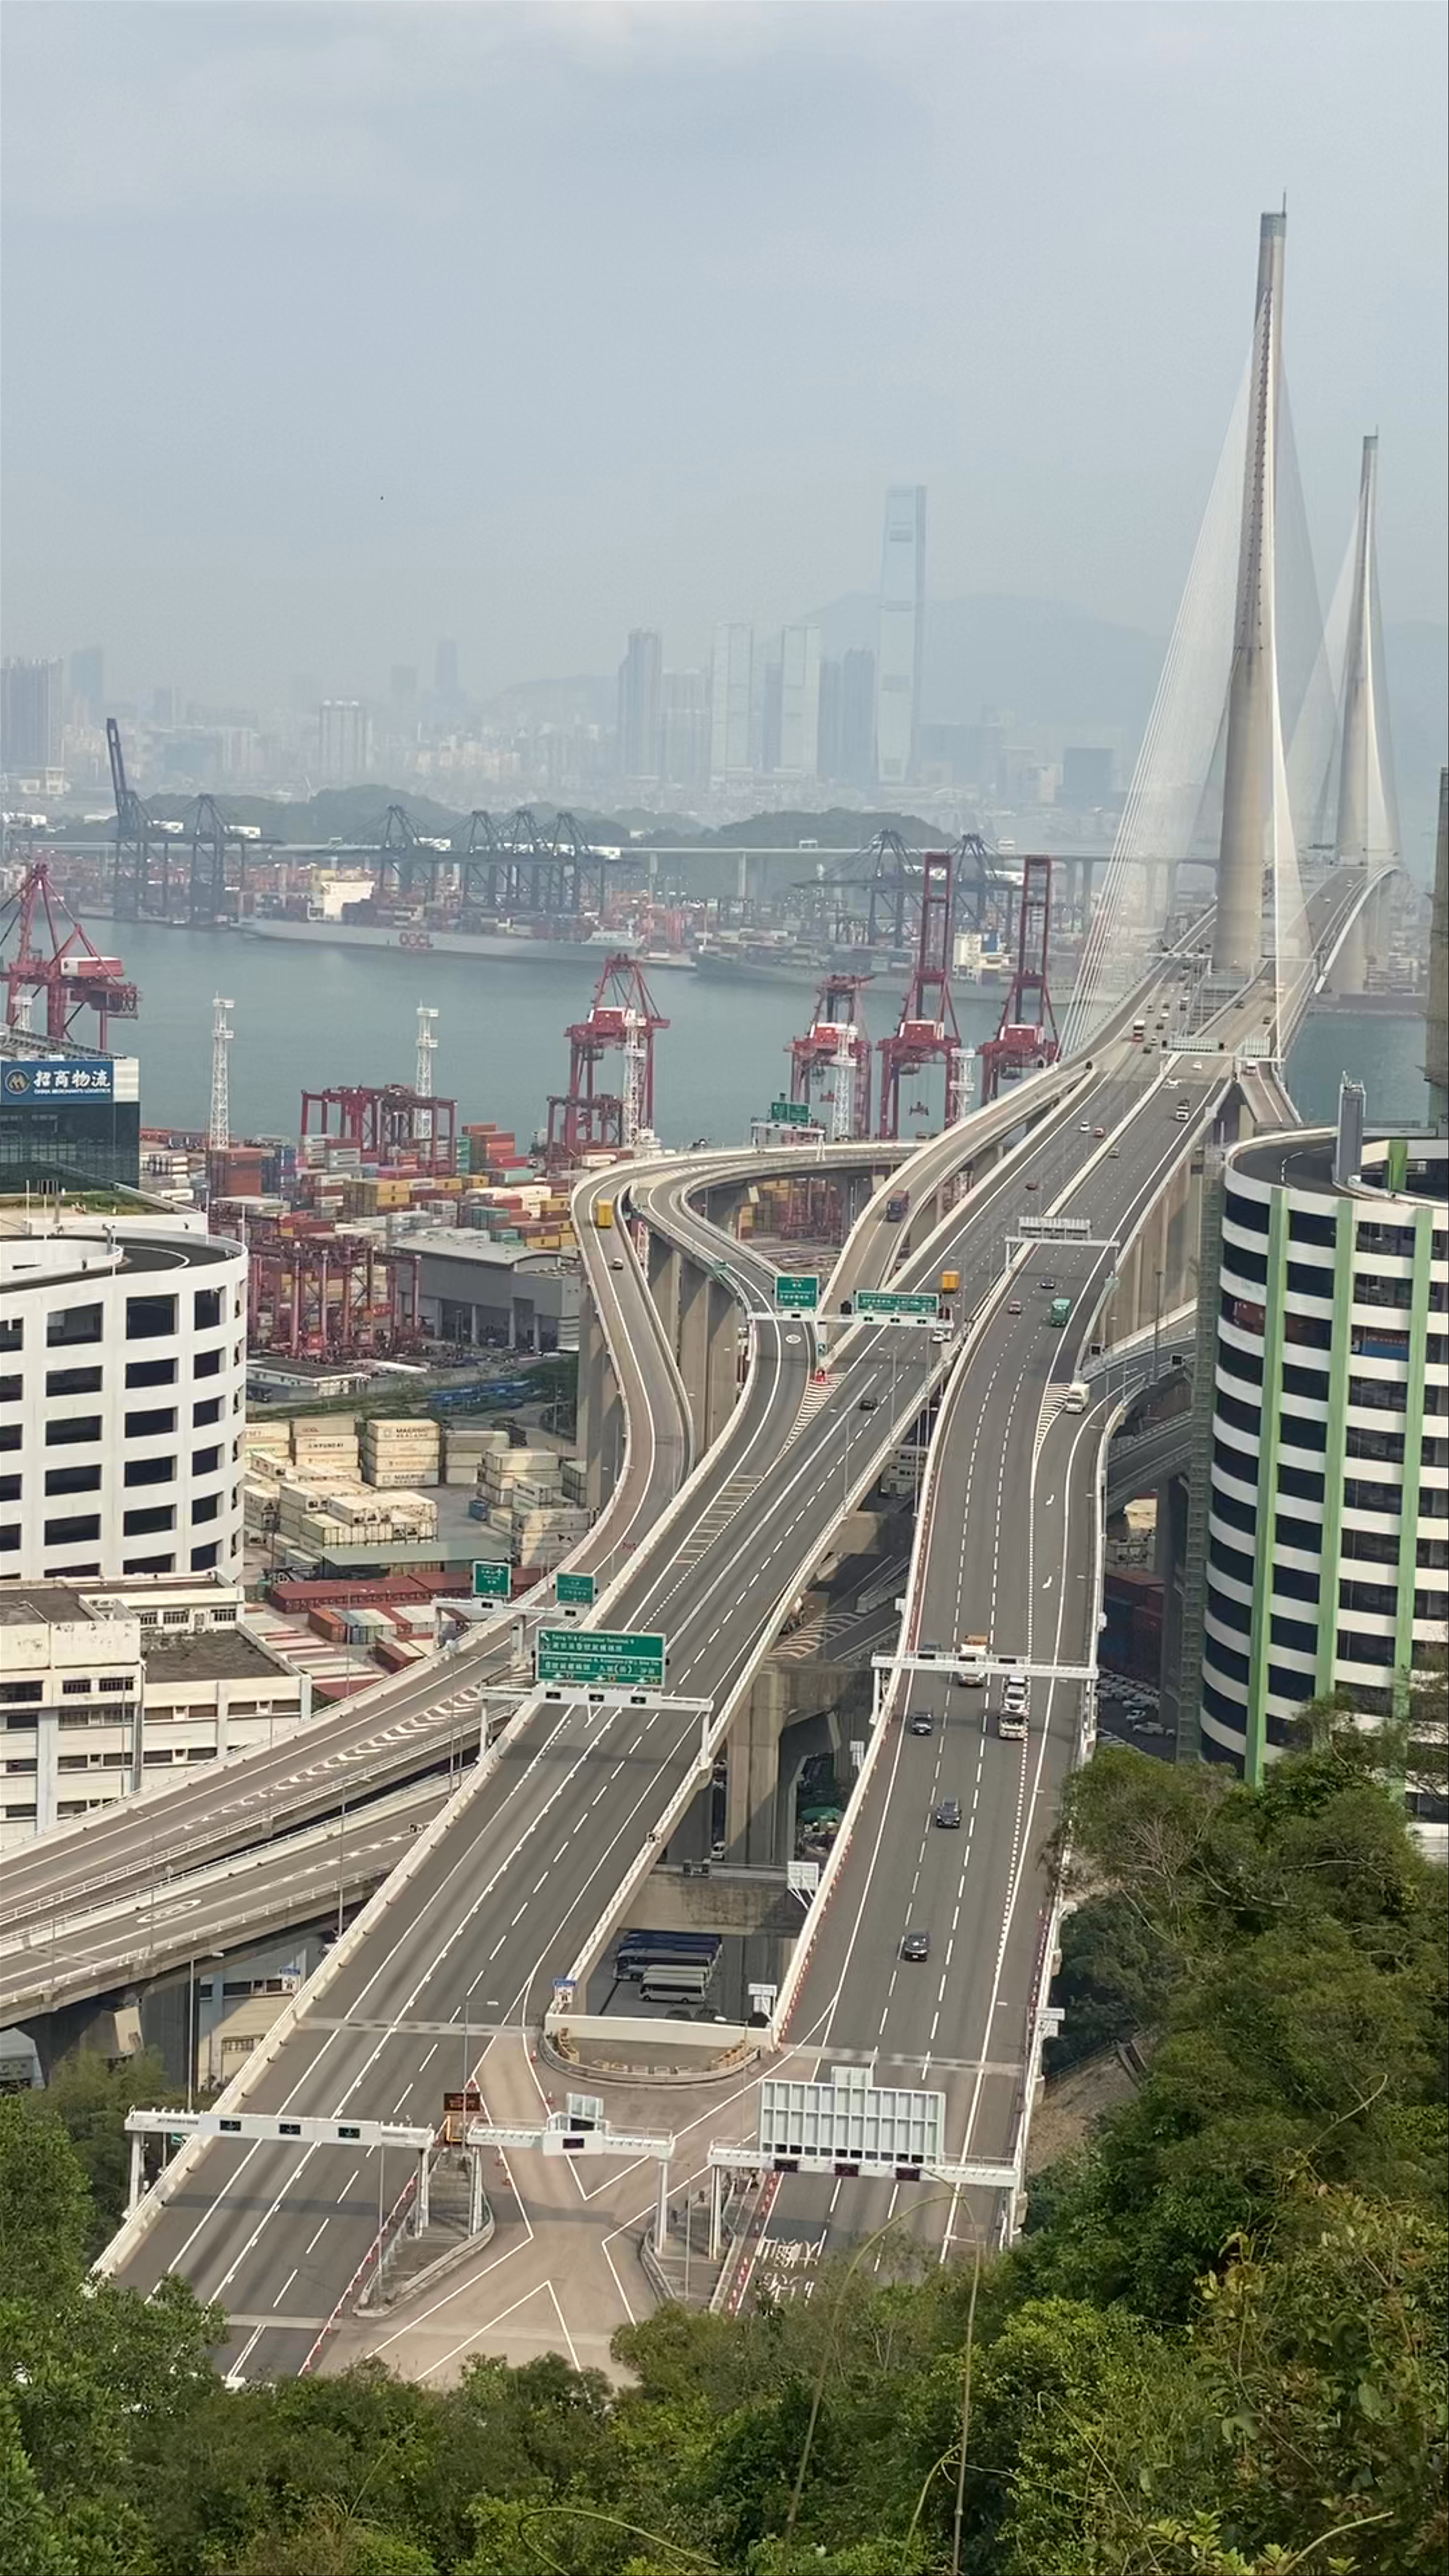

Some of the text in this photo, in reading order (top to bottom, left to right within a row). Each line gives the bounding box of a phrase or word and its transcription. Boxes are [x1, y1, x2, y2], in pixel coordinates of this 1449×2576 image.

[399, 932, 434, 947] OOCL
[33, 1069, 111, 1087] 招商物流
